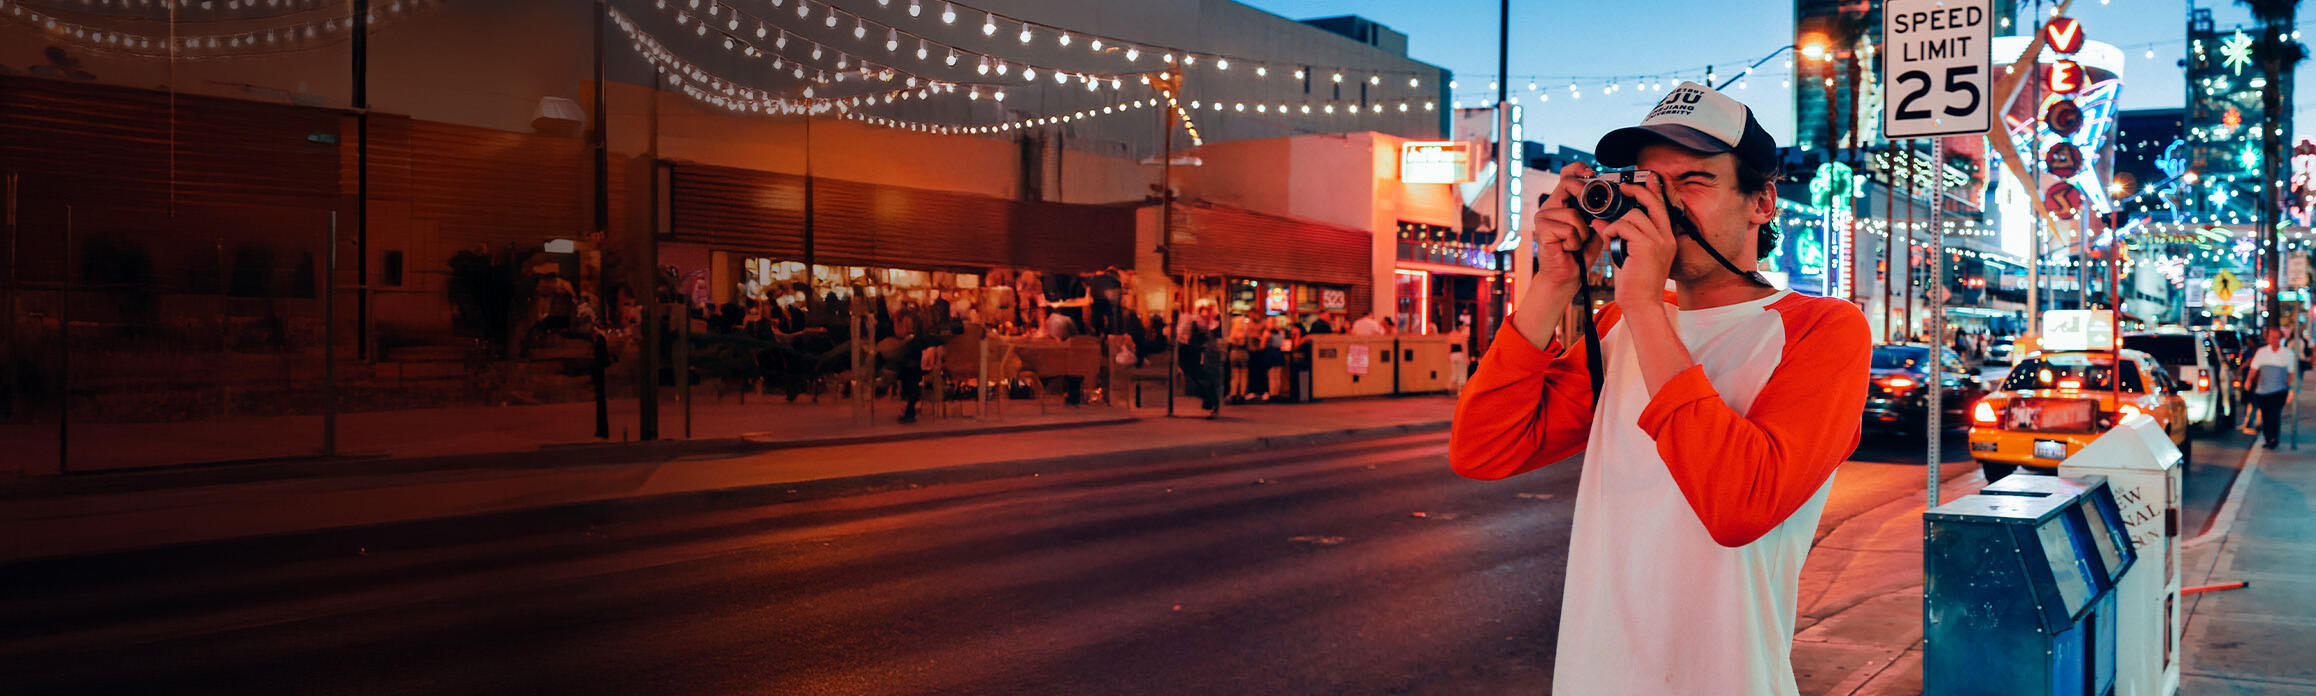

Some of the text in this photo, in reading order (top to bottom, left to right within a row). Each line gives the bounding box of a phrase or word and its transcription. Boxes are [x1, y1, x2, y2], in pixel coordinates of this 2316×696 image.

[1894, 6, 1982, 33] SPEED
[1903, 36, 1972, 62] LIMIT
[1895, 65, 1980, 120] 25
[2047, 18, 2083, 216] VEGAS
[1323, 290, 1345, 309] 523
